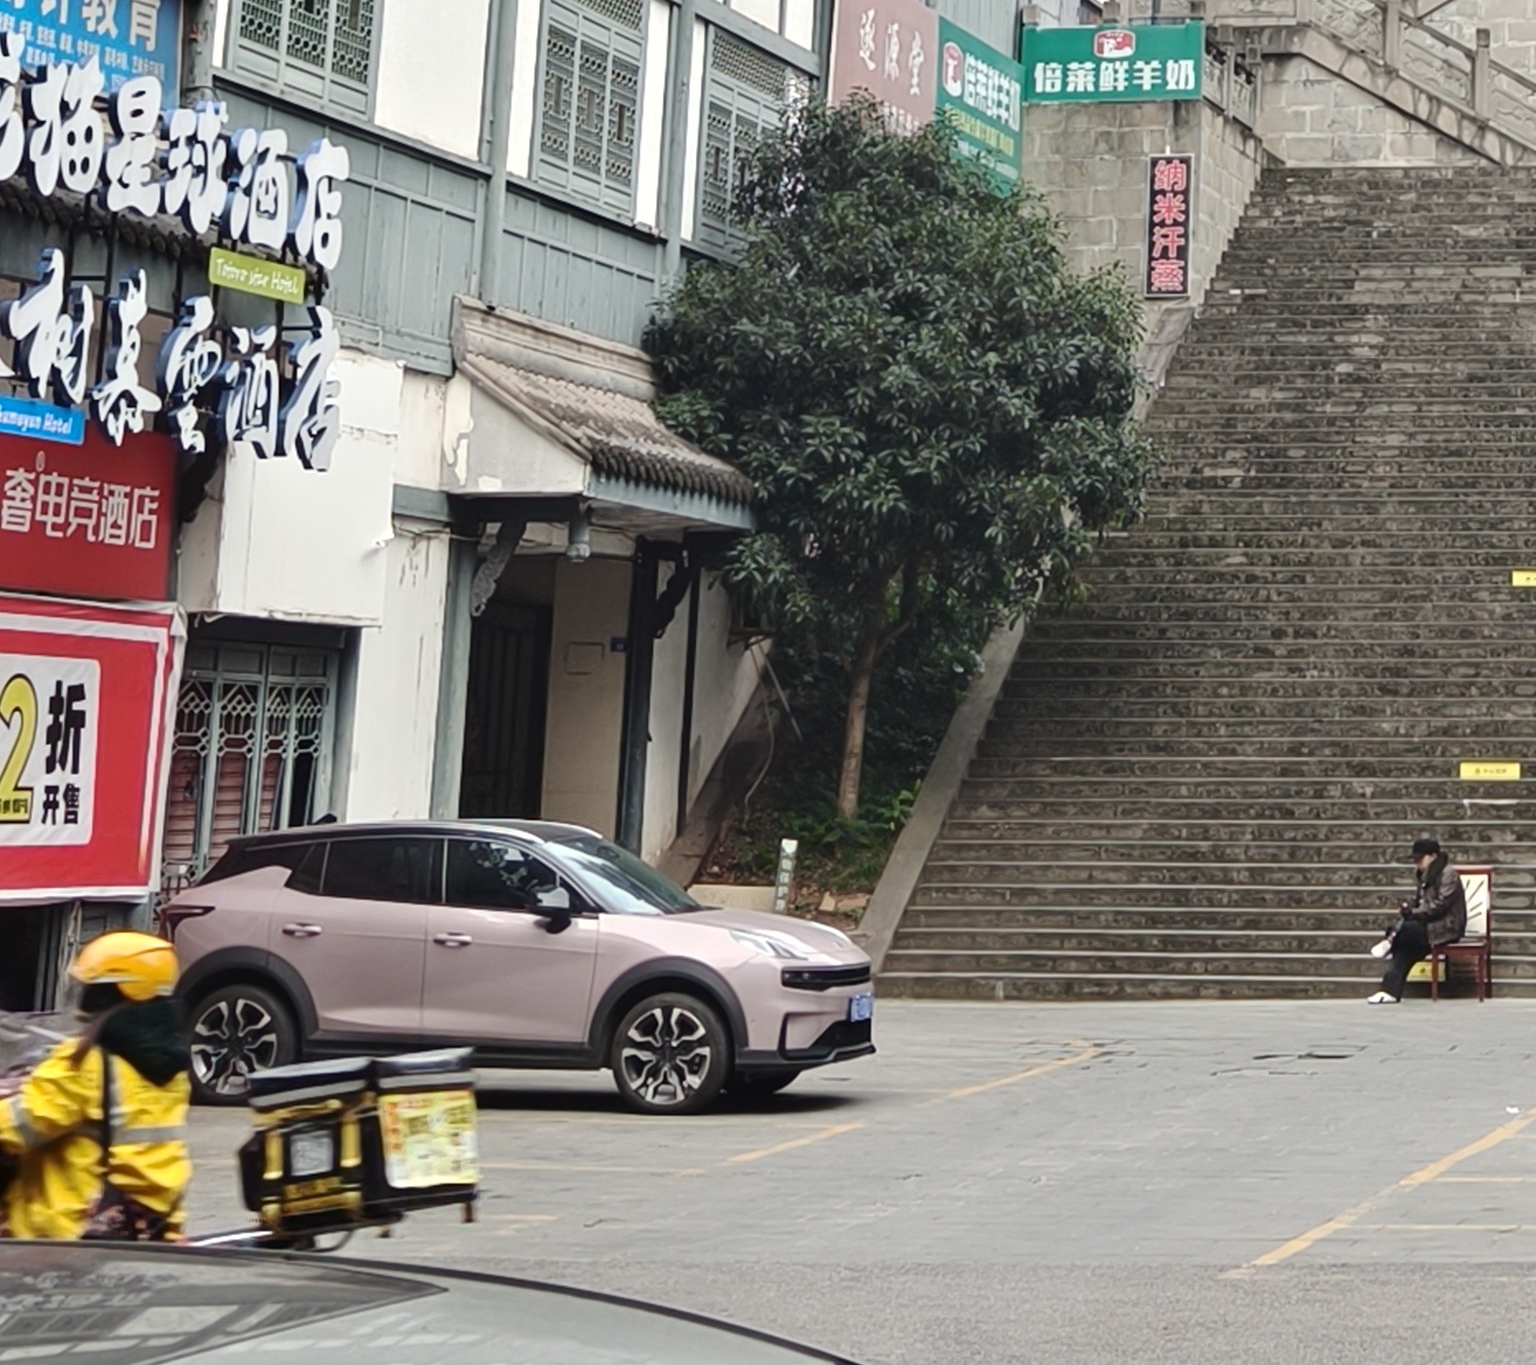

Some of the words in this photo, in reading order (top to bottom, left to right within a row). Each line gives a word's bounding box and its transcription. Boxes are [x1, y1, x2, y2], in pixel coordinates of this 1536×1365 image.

[1034, 59, 1196, 94] 倍莱鲜羊奶
[1152, 159, 1188, 292] 纳米汗蒸
[1, 467, 160, 549] 奢电竞酒店
[46, 680, 87, 775] 折
[41, 783, 81, 826] 开售
